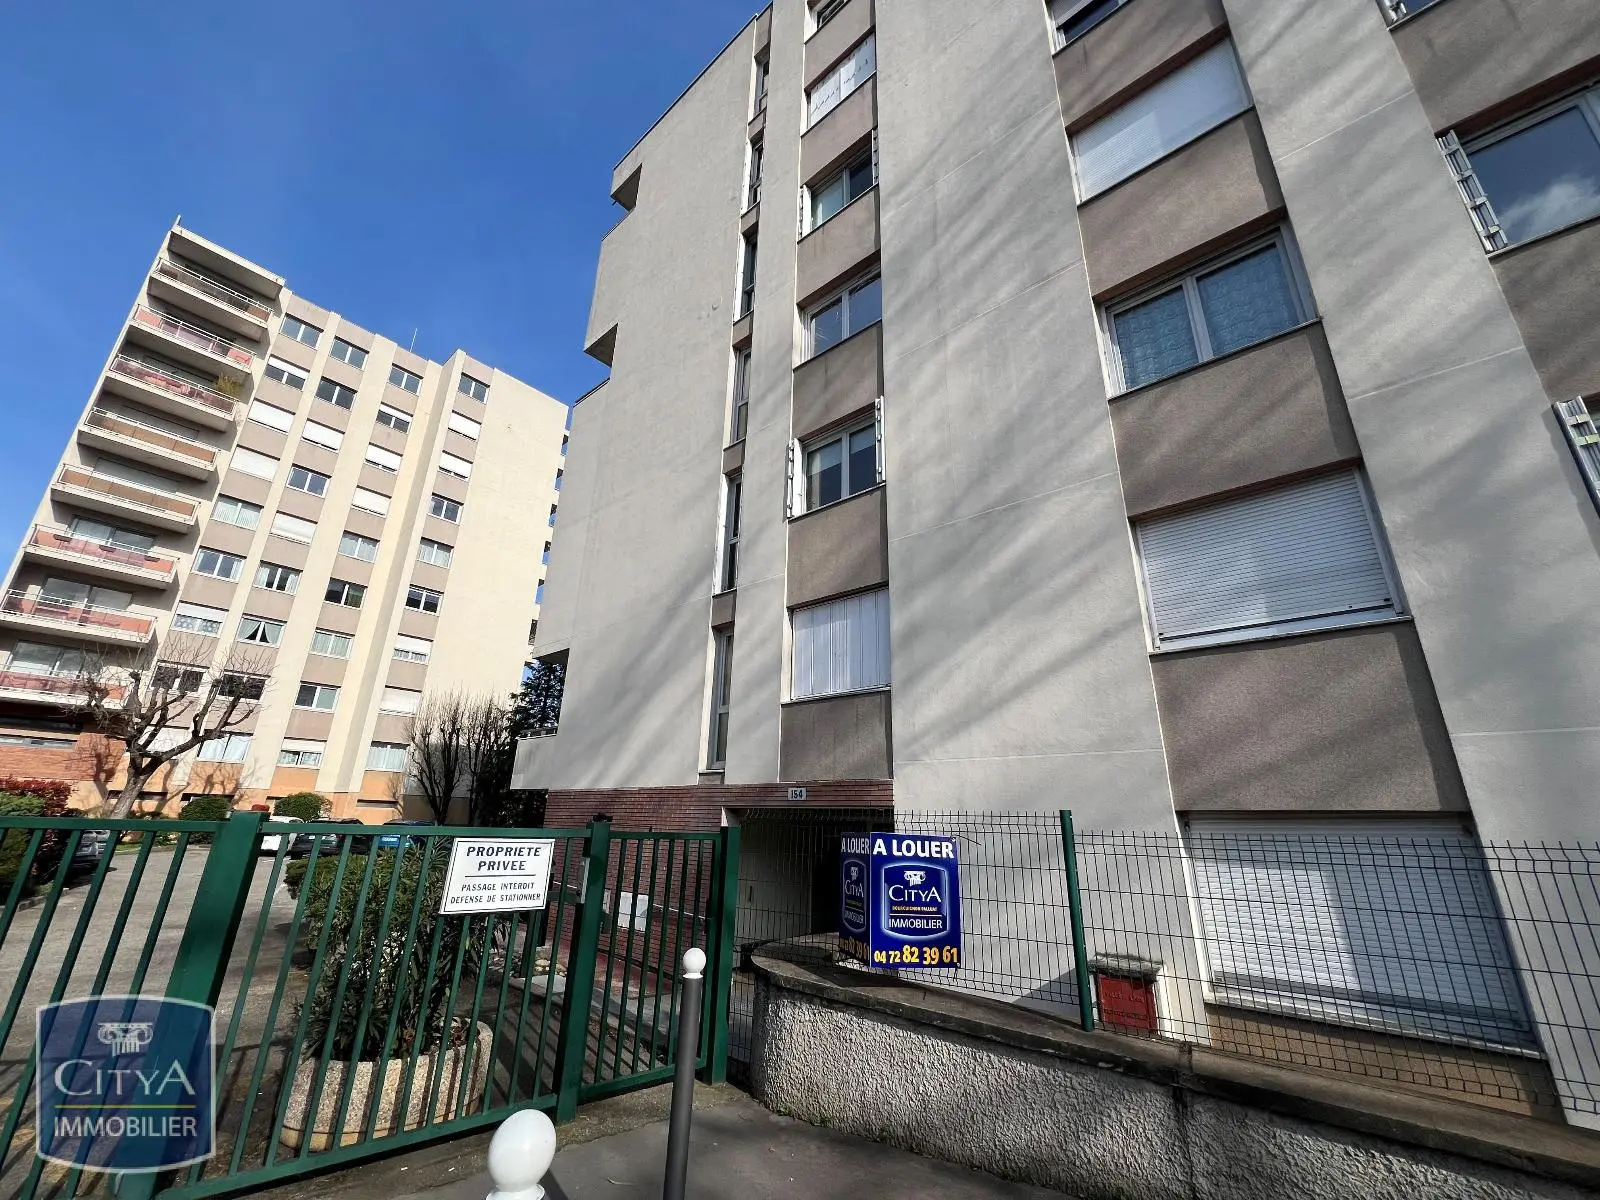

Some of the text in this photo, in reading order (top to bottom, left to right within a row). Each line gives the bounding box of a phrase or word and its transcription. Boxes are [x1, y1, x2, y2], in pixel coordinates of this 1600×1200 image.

[791, 789, 803, 799] 154
[466, 846, 542, 857] PROPRIETE
[847, 837, 870, 855] LOUER
[872, 838, 955, 859] A LOUER
[477, 860, 527, 871] PRIVEE
[461, 882, 535, 892] PASSAGE INTERDIT
[450, 893, 541, 904] DEFENSE DE STATIONNER
[888, 918, 943, 929] IMMOBILIER
[873, 944, 958, 965] 04 72 82 39 61
